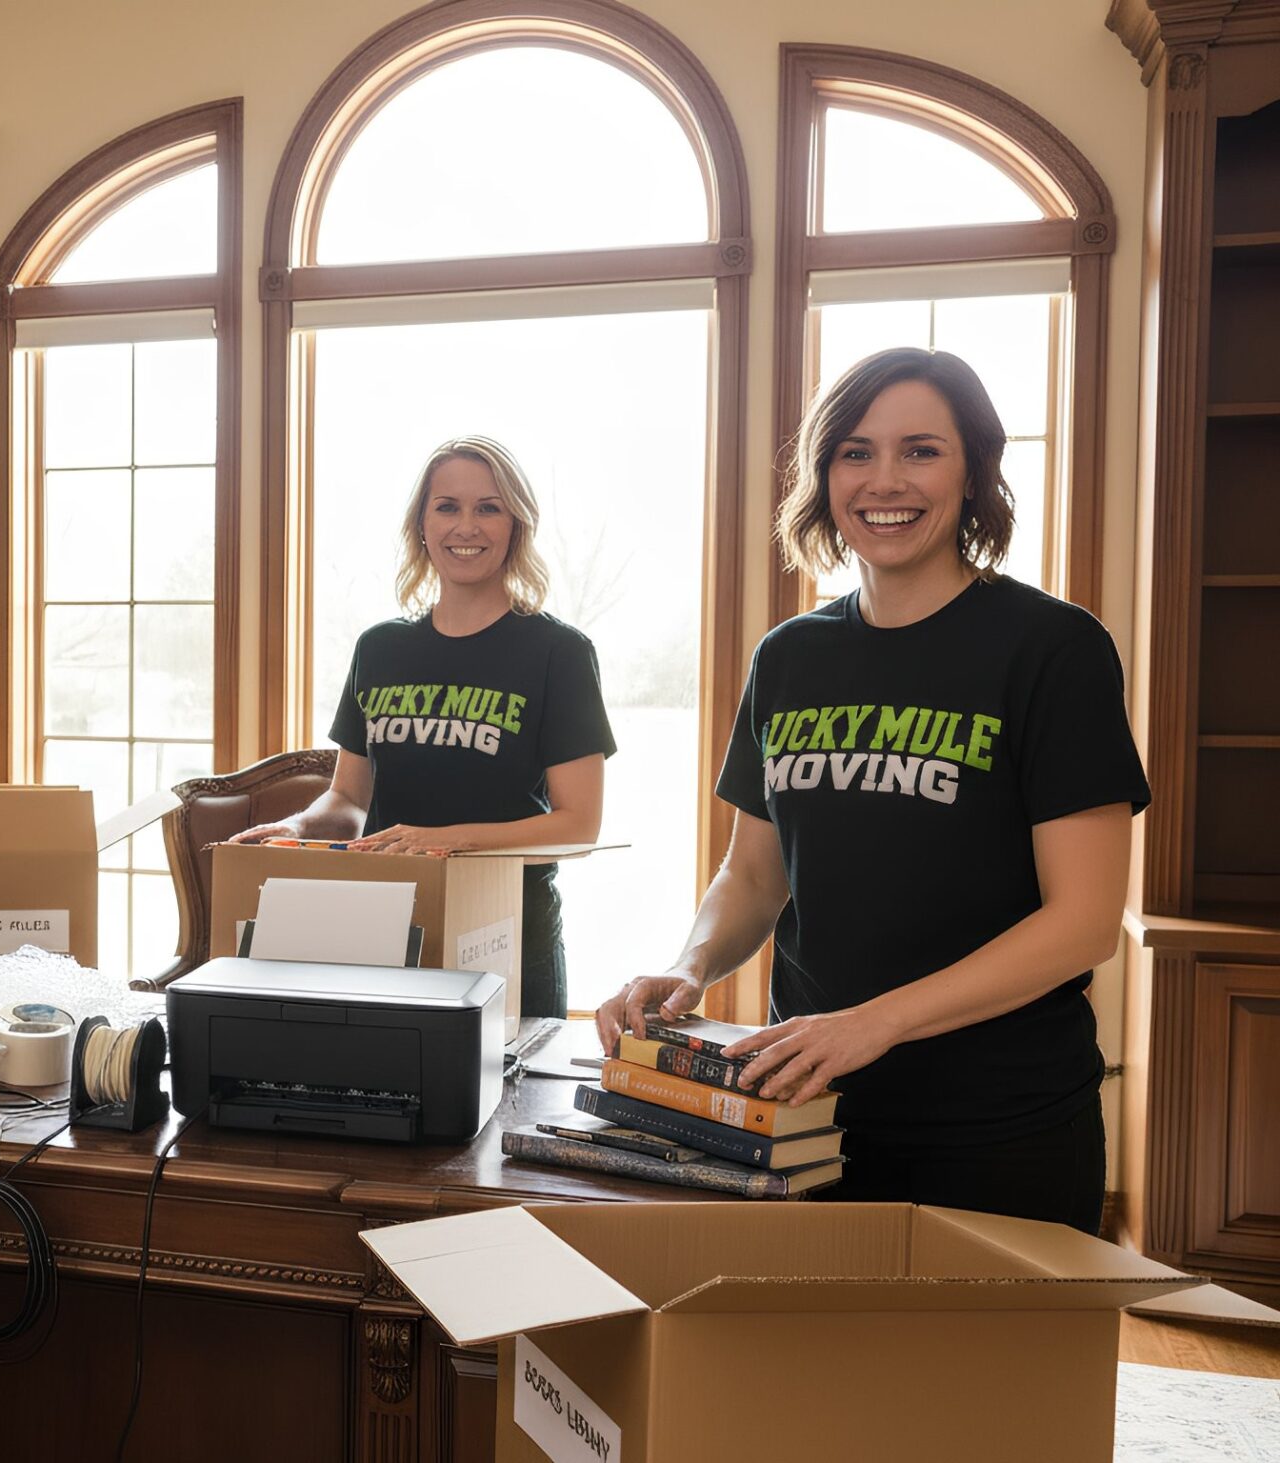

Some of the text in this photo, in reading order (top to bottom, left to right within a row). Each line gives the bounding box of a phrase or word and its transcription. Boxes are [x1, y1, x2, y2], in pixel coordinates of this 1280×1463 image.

[439, 685, 526, 735] MULE
[366, 716, 501, 756] MOVING
[762, 705, 1002, 772] UCKY MULE
[763, 753, 959, 805] MOVING
